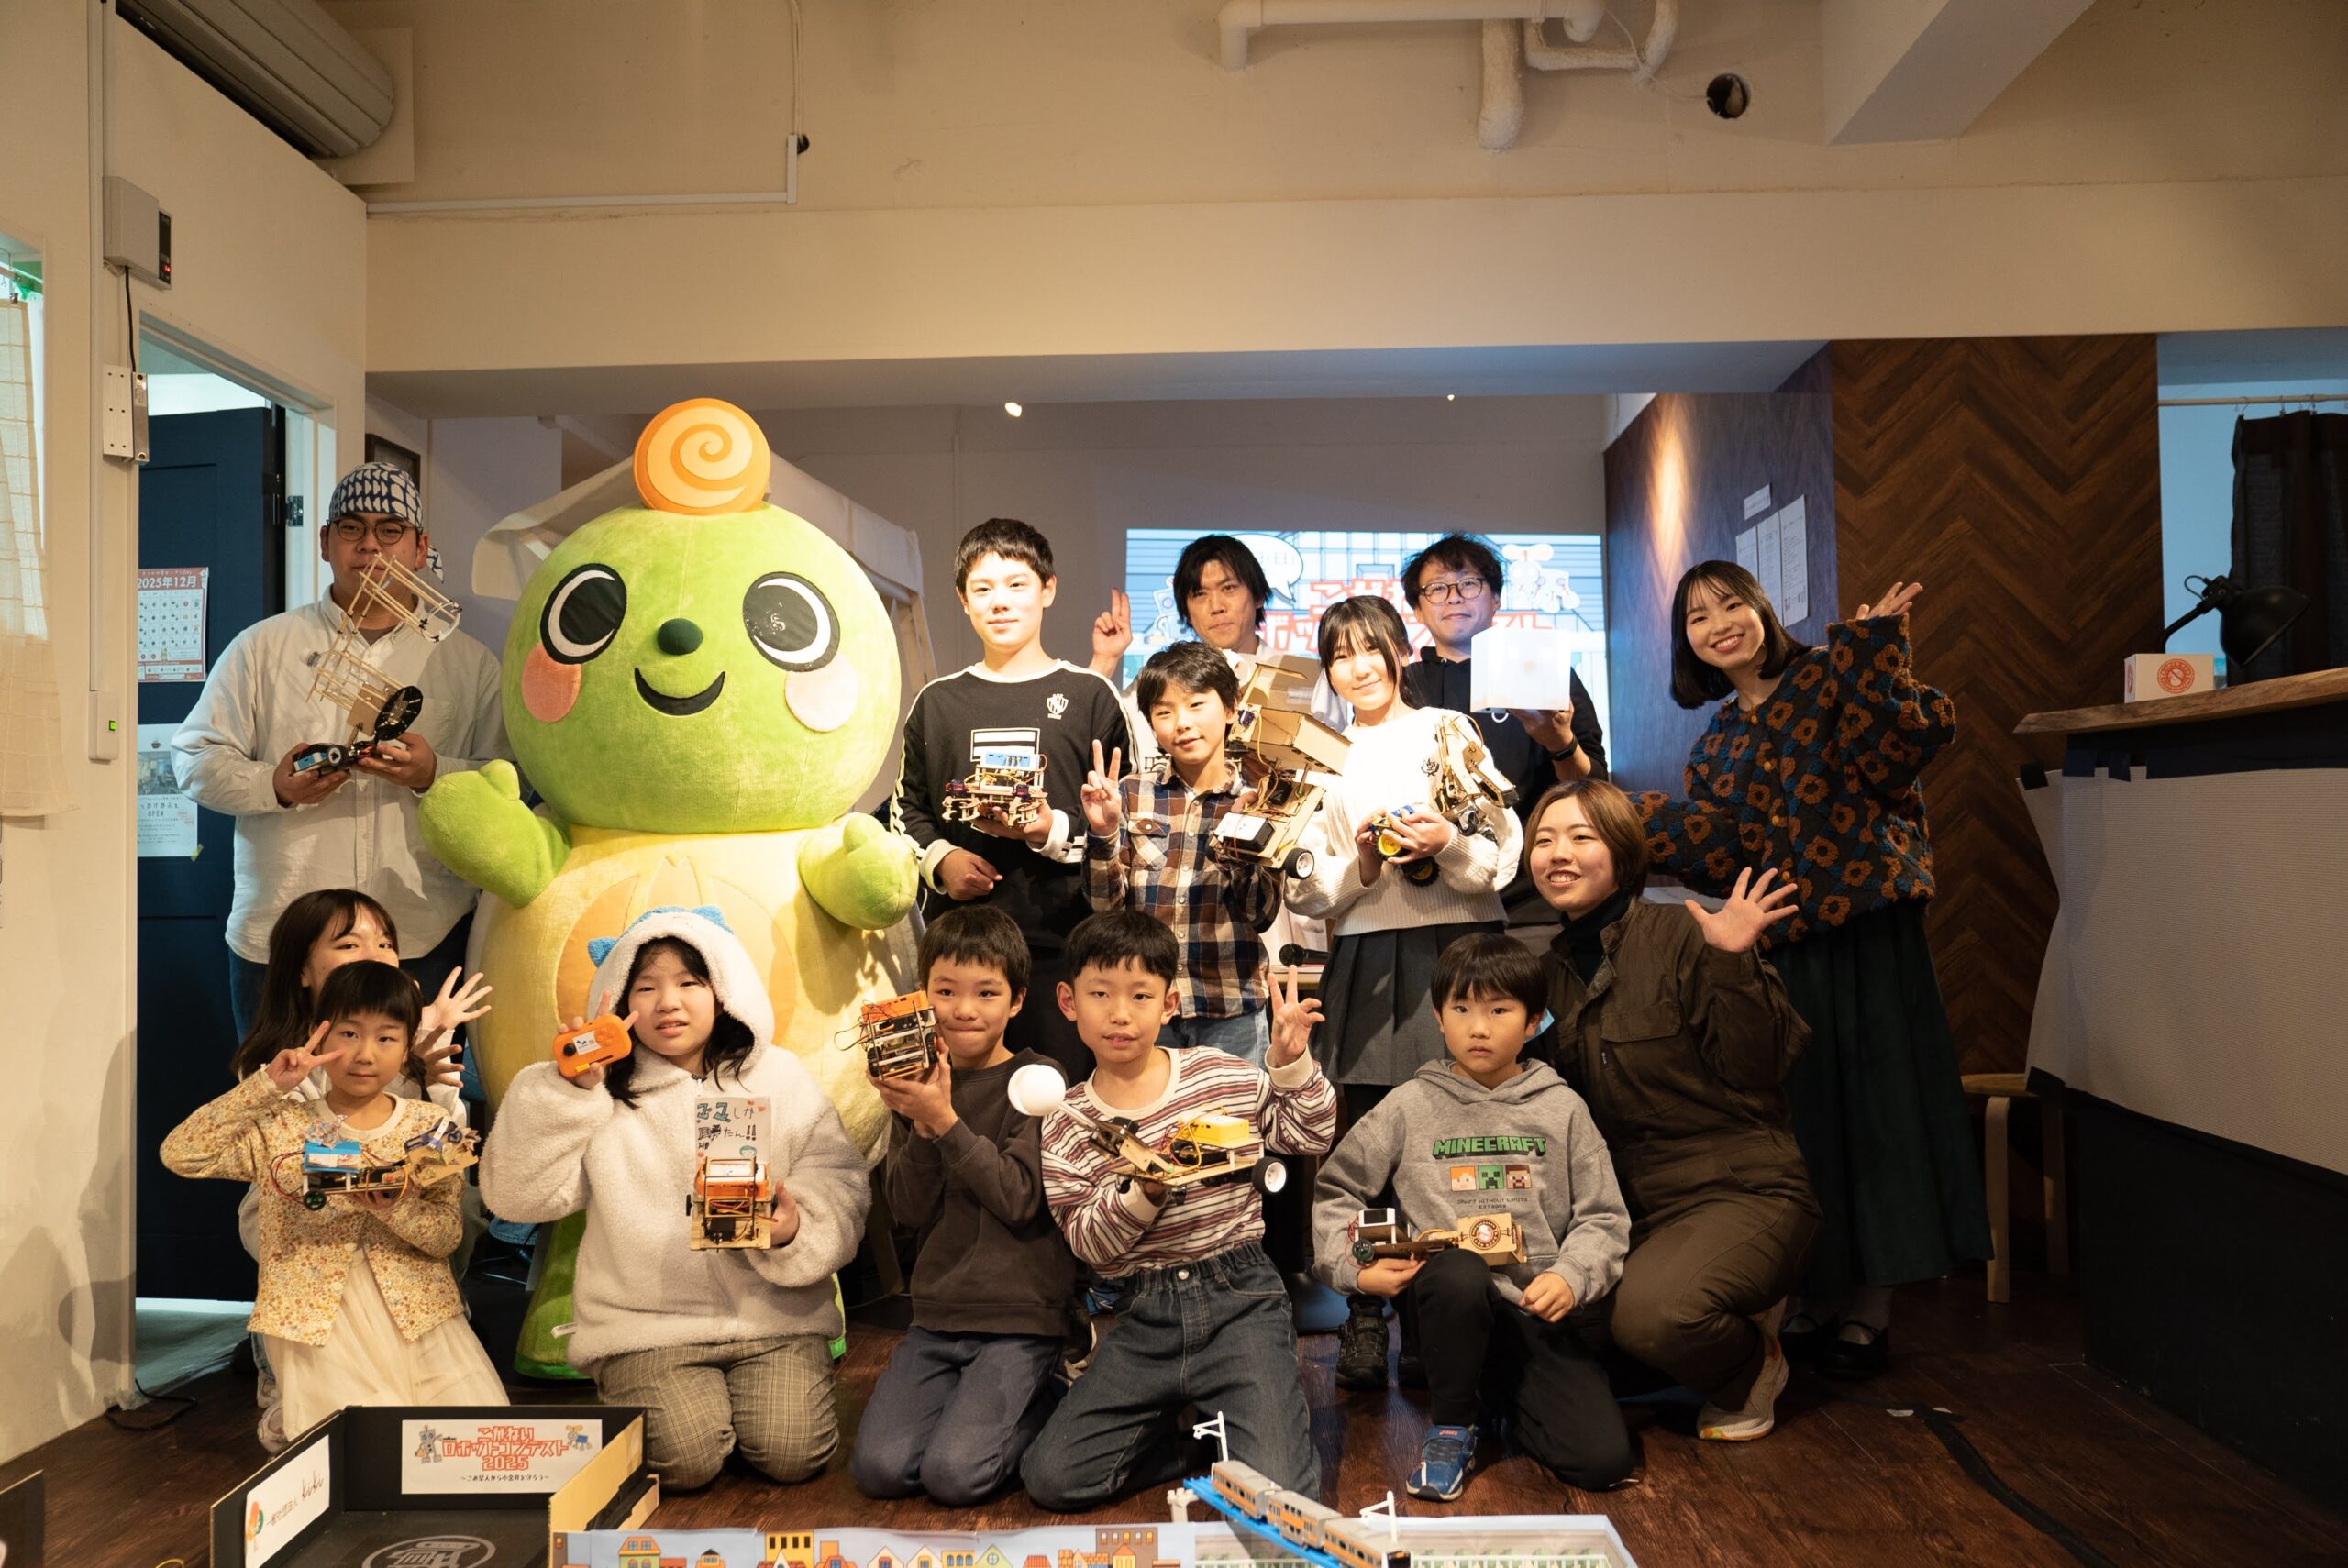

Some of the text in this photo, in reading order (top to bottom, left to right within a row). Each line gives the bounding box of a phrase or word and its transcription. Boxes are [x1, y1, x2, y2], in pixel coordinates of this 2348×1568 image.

[1432, 1135, 1547, 1159] MINECRAFT
[477, 1425, 535, 1441] こがねい
[441, 1439, 570, 1457] ロボットコンテスト
[482, 1454, 529, 1471] 2025
